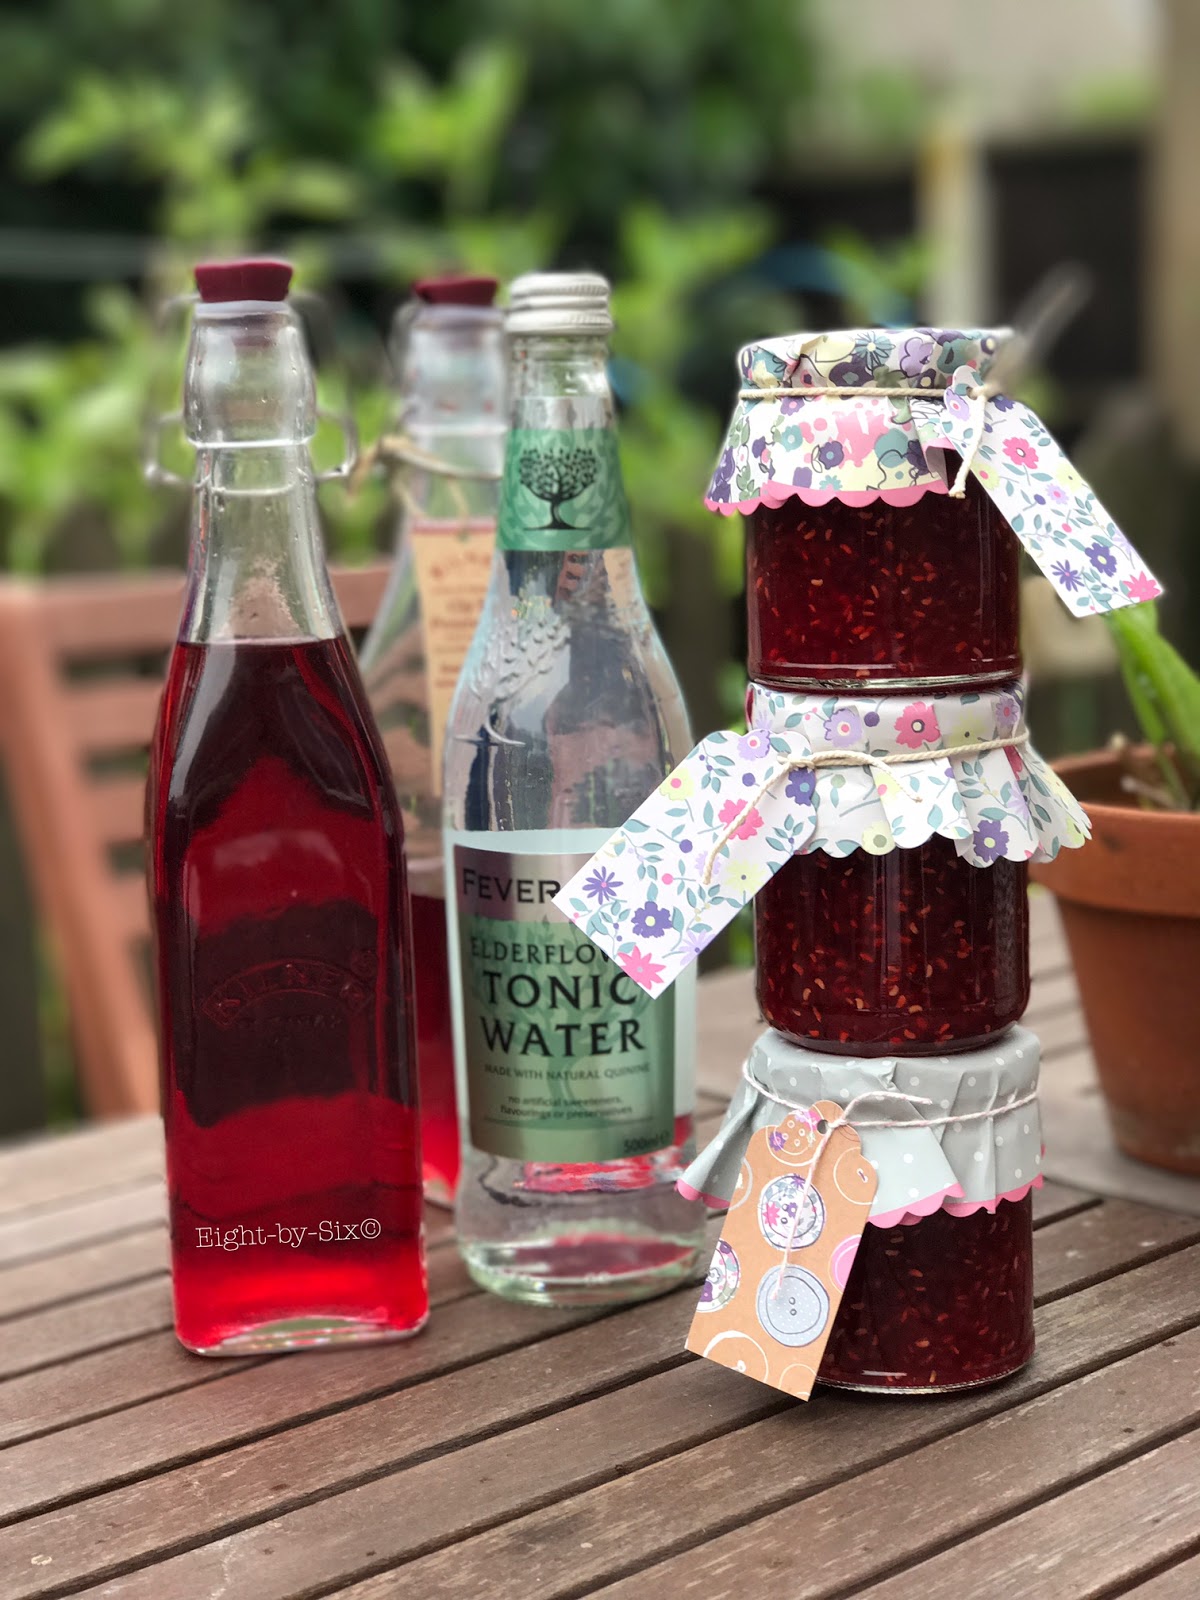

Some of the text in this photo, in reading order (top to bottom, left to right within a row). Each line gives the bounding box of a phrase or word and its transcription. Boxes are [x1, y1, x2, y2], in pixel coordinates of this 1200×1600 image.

[463, 868, 561, 904] FEVER
[470, 935, 609, 966] ELDERFLO
[482, 970, 638, 1010] TONIC
[480, 1016, 646, 1057] WATER
[484, 1062, 650, 1082] MADE WITH NATURAL QUININE
